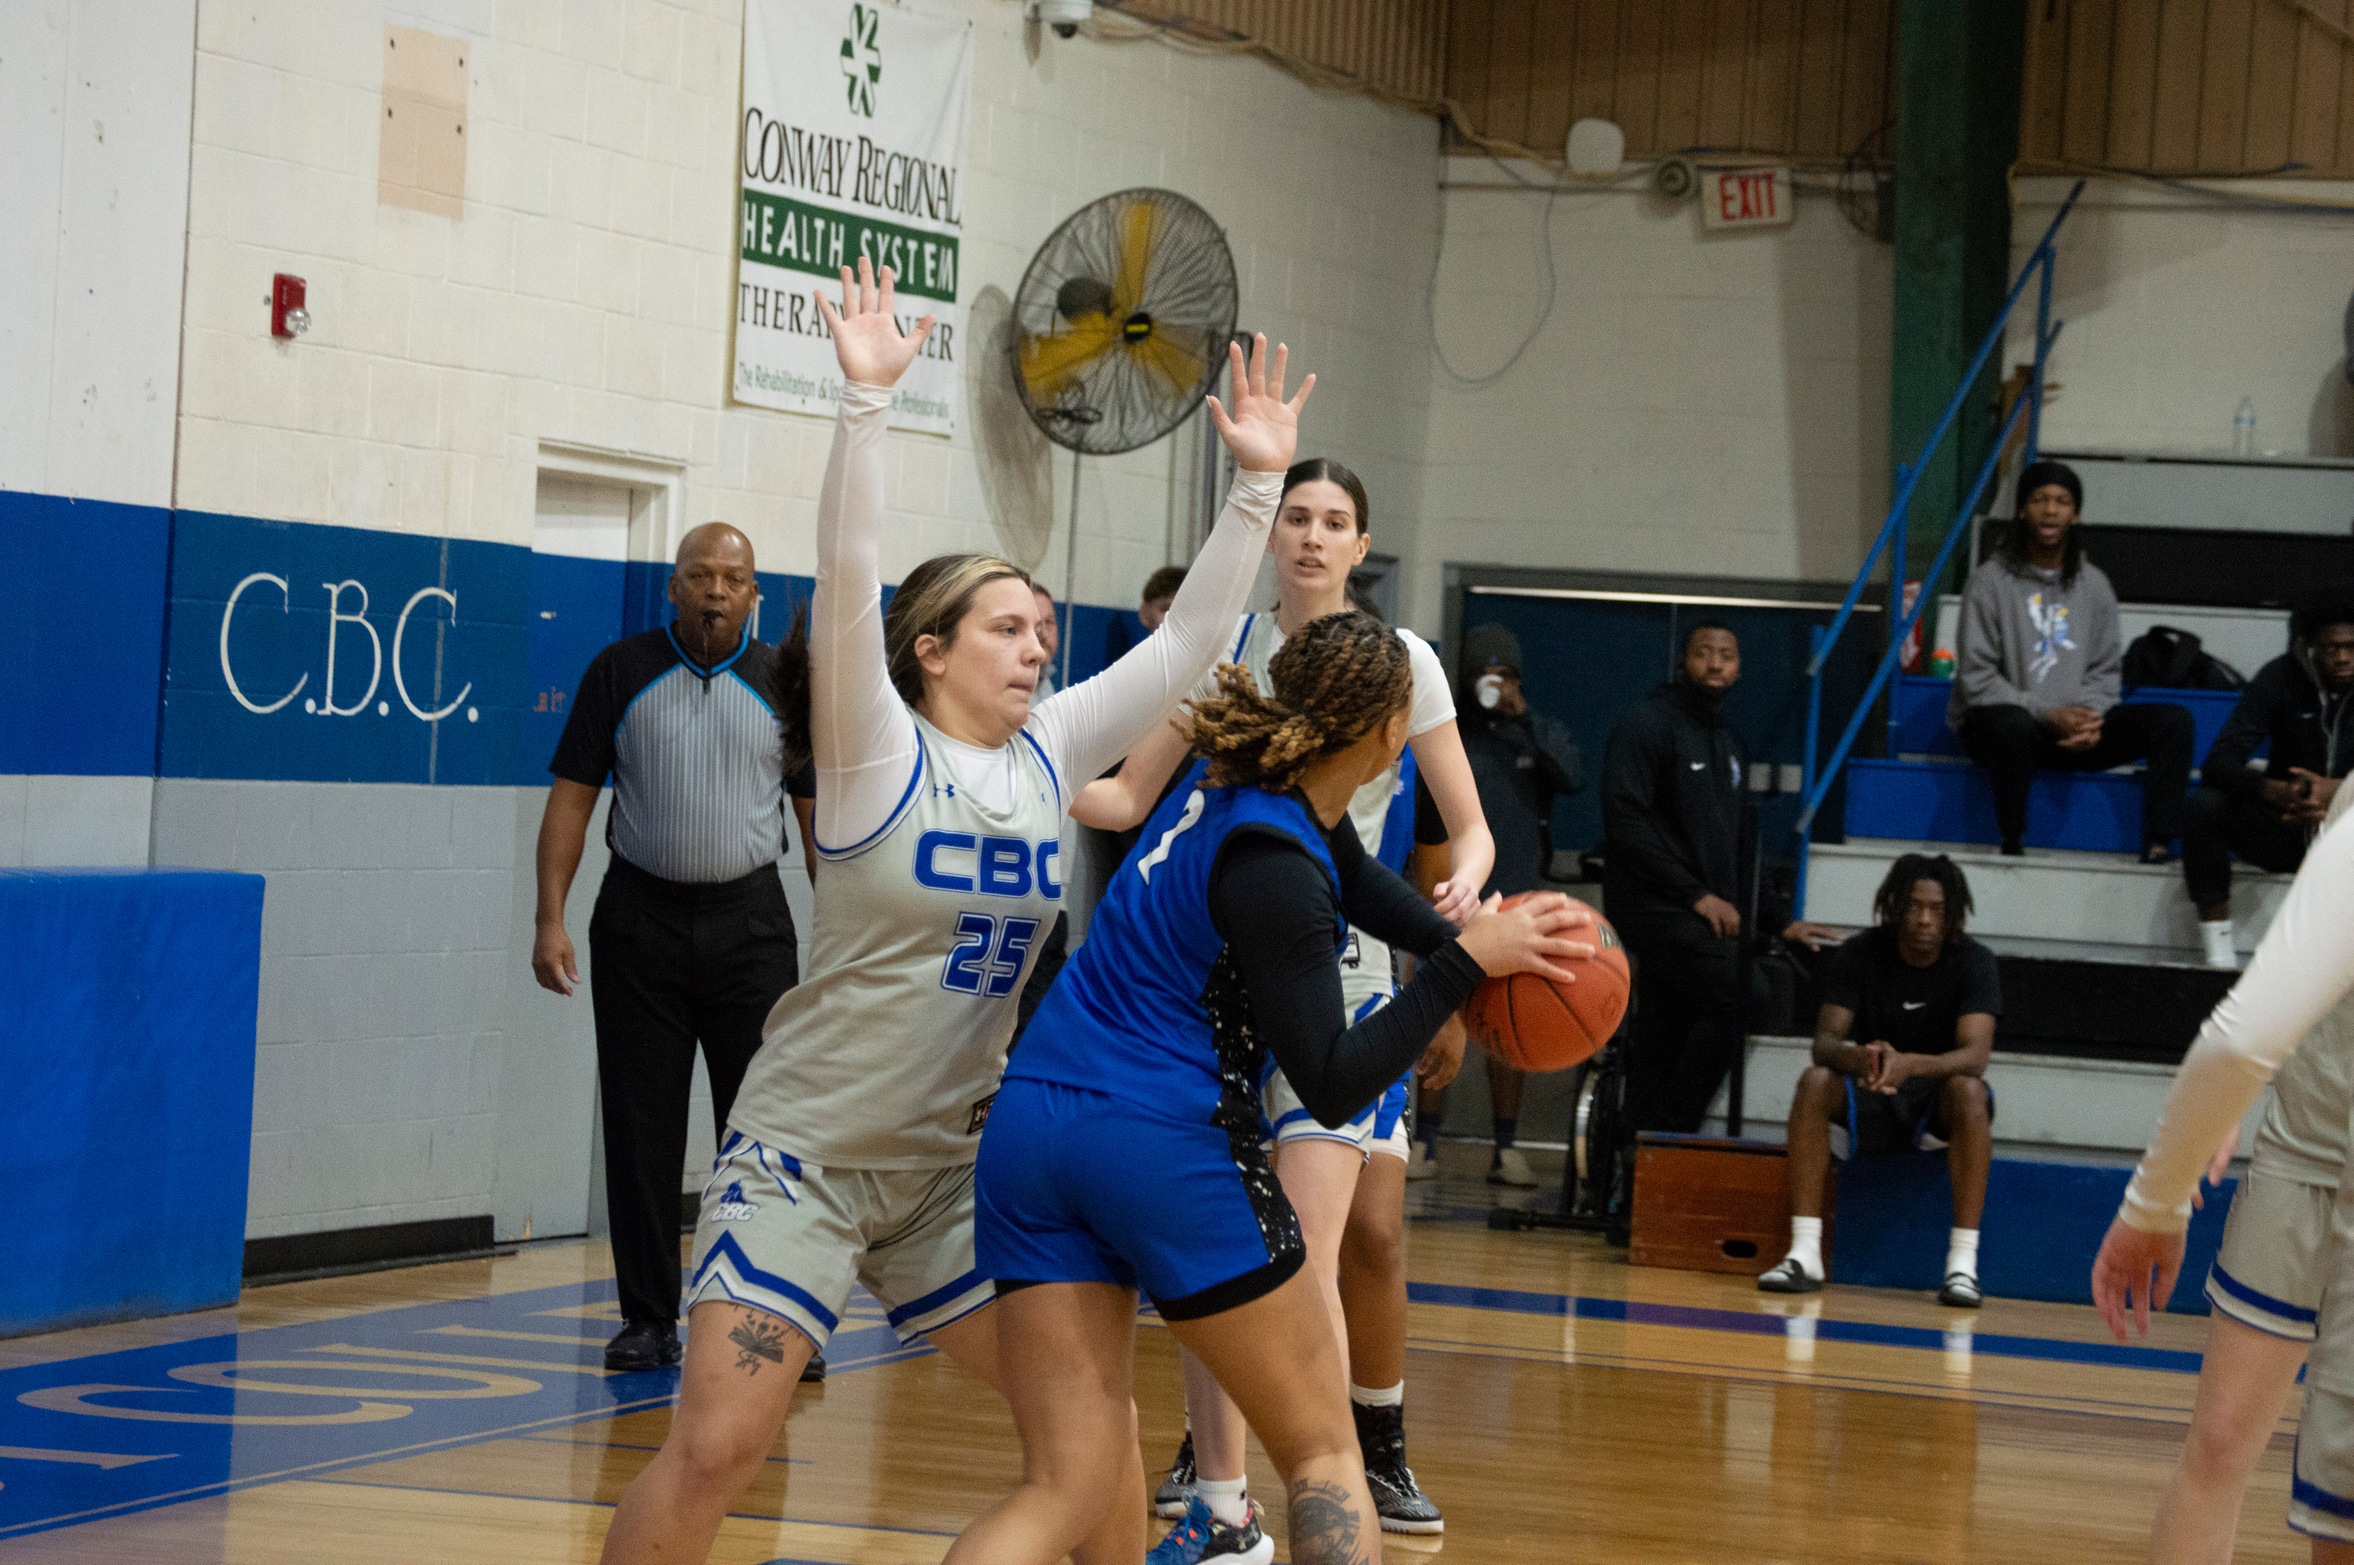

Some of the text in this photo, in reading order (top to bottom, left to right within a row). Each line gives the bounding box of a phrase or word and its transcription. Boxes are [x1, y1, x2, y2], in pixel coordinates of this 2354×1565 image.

[744, 106, 961, 226] CONWAY REGIONAL
[1718, 171, 1775, 221] EXIT
[742, 202, 954, 292] HEALTH SYSTEM
[220, 572, 480, 724] C.B.C.
[940, 911, 1042, 999] 25
[711, 1202, 760, 1223] CBC
